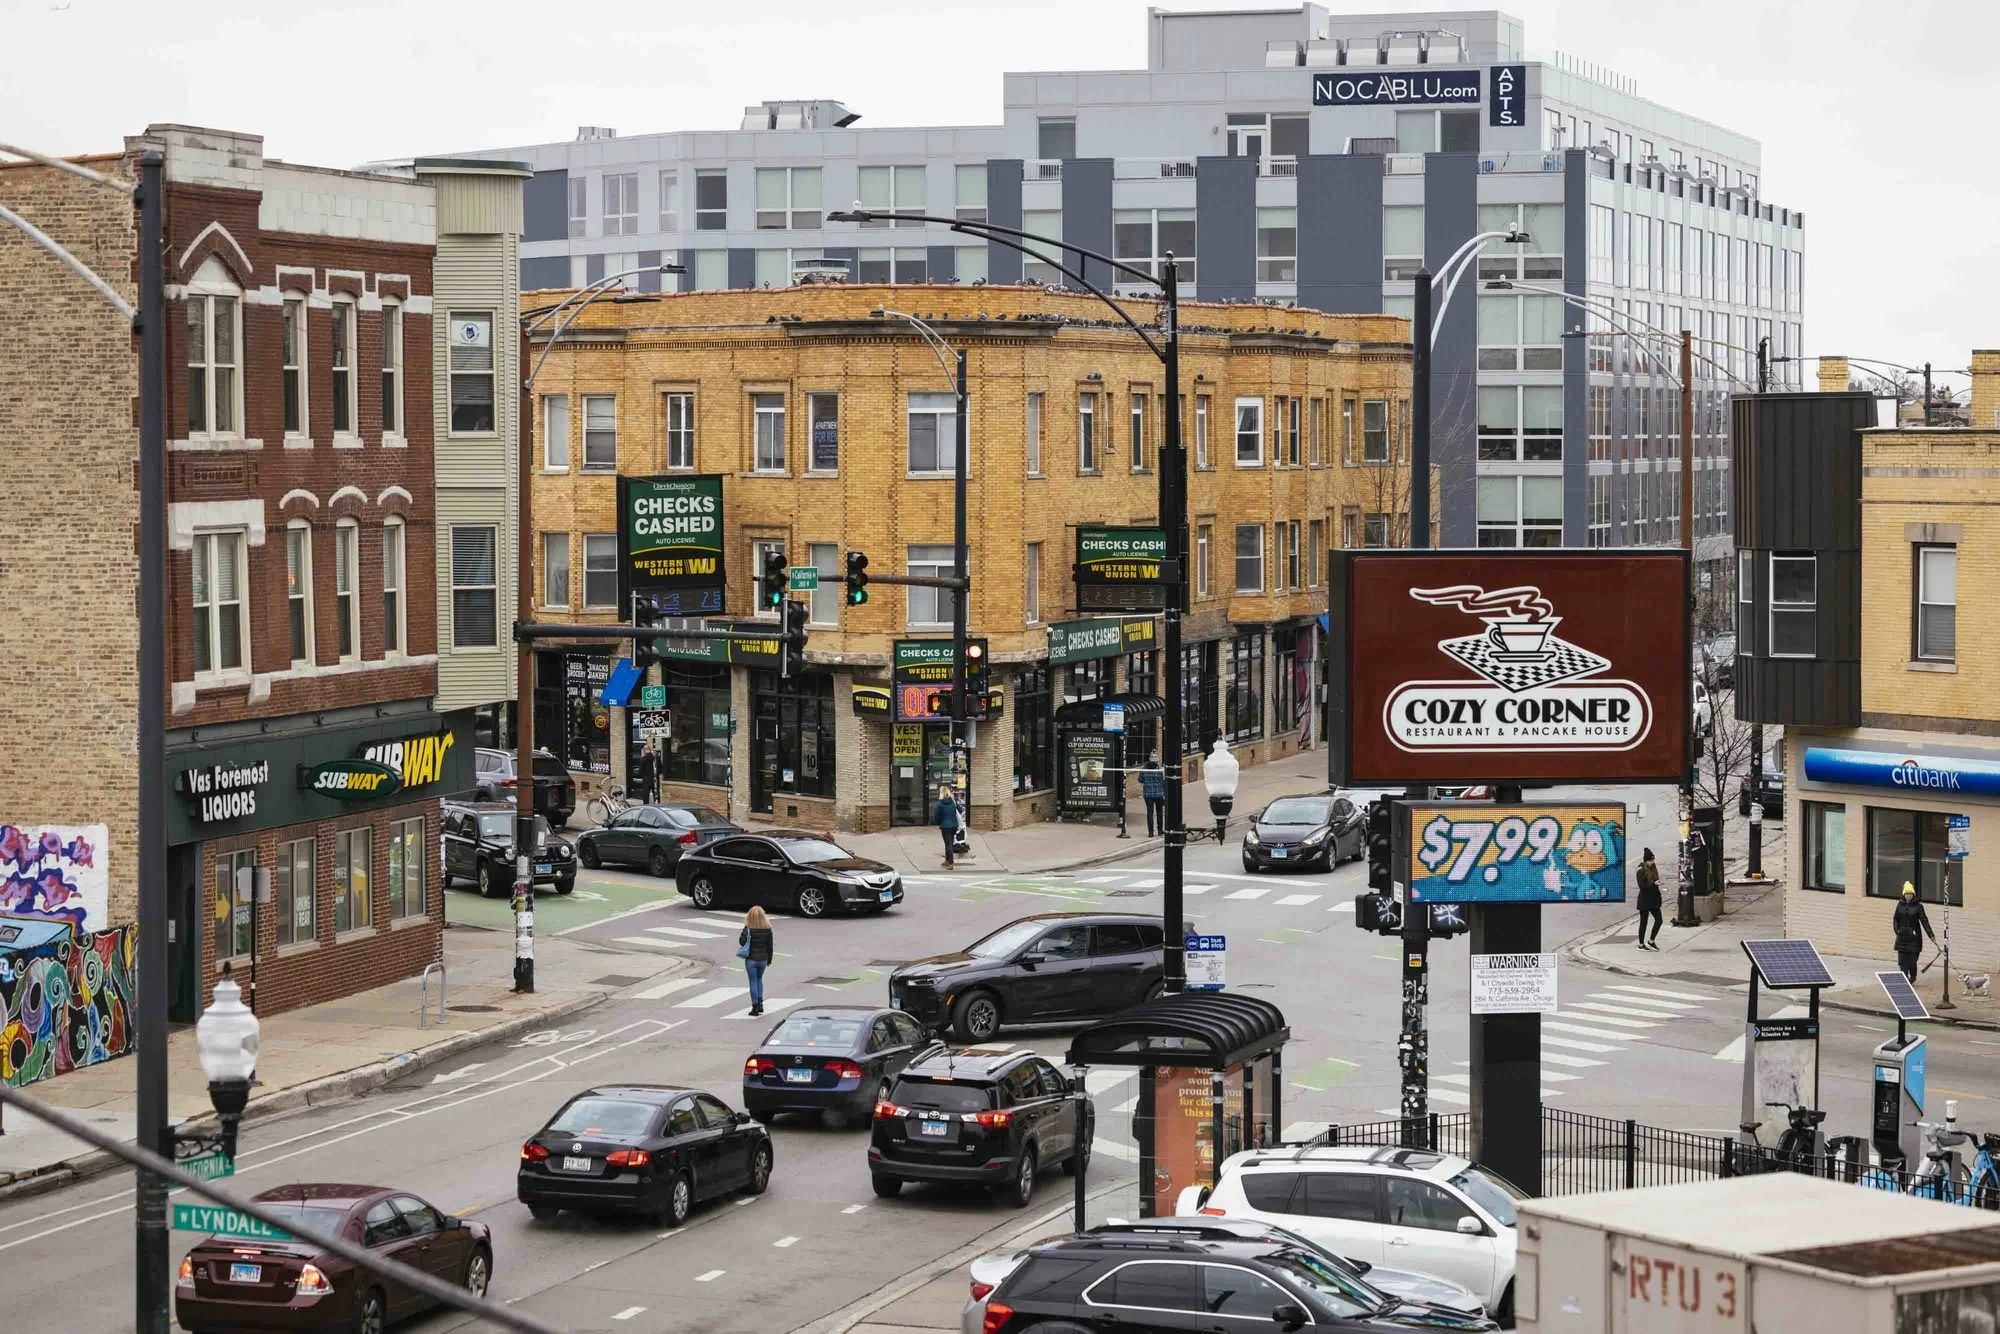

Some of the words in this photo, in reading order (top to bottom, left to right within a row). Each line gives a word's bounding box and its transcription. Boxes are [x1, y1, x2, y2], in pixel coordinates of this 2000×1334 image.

[1498, 68, 1518, 124] APTS.
[634, 496, 715, 515] CHECKS
[635, 516, 715, 535] CASHED
[1082, 541, 1129, 550] CHECKS
[1132, 541, 1166, 550] CASH
[634, 559, 683, 569] WESTERN
[688, 558, 716, 575] WU
[650, 567, 683, 576] UNION
[1142, 565, 1160, 579] W
[1052, 630, 1064, 641] AUTO
[1068, 630, 1094, 651] CHECKS
[1095, 627, 1120, 647] CASHED
[1124, 623, 1141, 633] WESTERN
[1142, 620, 1154, 639] WU
[1129, 631, 1142, 642] UNION
[742, 645, 760, 653] UNION
[900, 649, 940, 658] CHECKS
[569, 662, 583, 670] BEER
[1405, 698, 1487, 724] COZY
[1495, 697, 1631, 724] CORNER
[895, 725, 921, 735] YES!
[1406, 727, 1491, 736] RESTAURANT
[1498, 727, 1505, 736] &
[1513, 727, 1578, 736] PANCAKE
[1585, 726, 1629, 736] HOUSE
[894, 746, 921, 754] OPEN!
[570, 759, 583, 768] WINE
[590, 762, 609, 771] LIQUOR
[189, 768, 211, 794] Vas
[215, 760, 268, 791] Foremost
[314, 771, 387, 790] SUBWAY
[1892, 765, 1960, 789] citibank
[202, 790, 256, 823] LIQUORS
[1419, 816, 1561, 883] $7.99
[1489, 955, 1538, 968] WARNING
[1179, 1088, 1209, 1097] proud
[1179, 1096, 1194, 1106] for
[1185, 1108, 1204, 1117] this
[180, 1212, 188, 1223] W
[1628, 1253, 1700, 1313] RTU
[1715, 1271, 1737, 1319] 3
